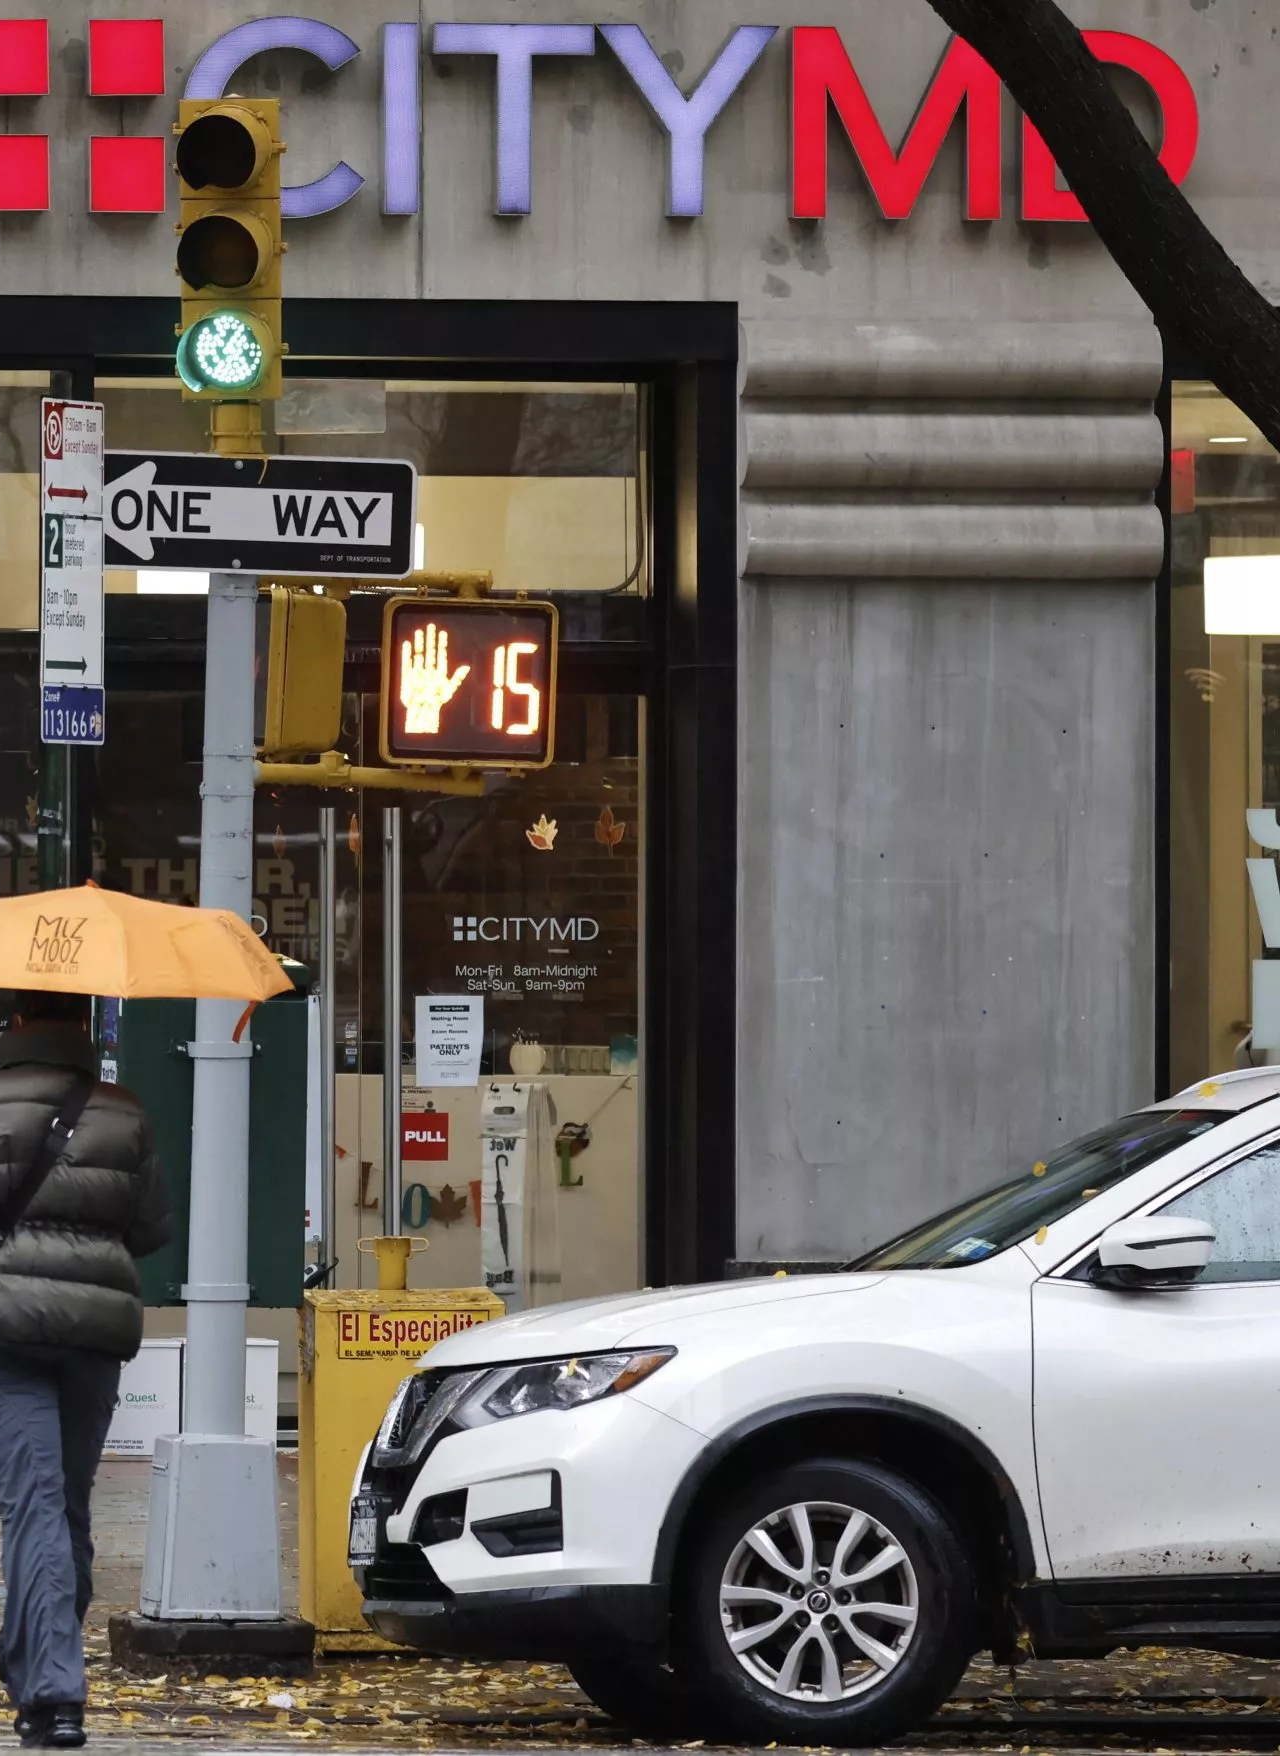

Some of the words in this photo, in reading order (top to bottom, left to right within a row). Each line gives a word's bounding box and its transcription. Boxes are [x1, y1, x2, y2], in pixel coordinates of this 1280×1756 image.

[186, 15, 1200, 223] CITYMD
[87, 419, 97, 432] 8am
[65, 439, 81, 455] Except
[82, 440, 98, 457] Sunday
[110, 487, 212, 533] ONE
[272, 494, 382, 539] WAY
[64, 520, 77, 534] hour
[49, 518, 60, 563] 2
[65, 538, 85, 552] metered
[65, 553, 83, 569] parking
[320, 554, 334, 562] DEPT
[346, 555, 392, 563] TRANSPORTATION
[46, 588, 59, 605] 8am
[64, 589, 78, 608] 10pm
[46, 610, 65, 630] Except
[66, 610, 86, 631] Sunday
[491, 642, 540, 735] 15
[44, 708, 87, 738] 113166
[478, 916, 600, 942] CITYMD
[28, 937, 84, 963] MOOZ
[455, 965, 503, 977] Mon-Fri
[513, 965, 598, 979] 8am-Midnight
[467, 979, 516, 991] Sat-Sun
[525, 979, 585, 993] 9am-9pm
[404, 1130, 446, 1142] PULL
[342, 1313, 360, 1342] El
[369, 1313, 485, 1349] Especialit
[125, 1392, 157, 1403] Quest
